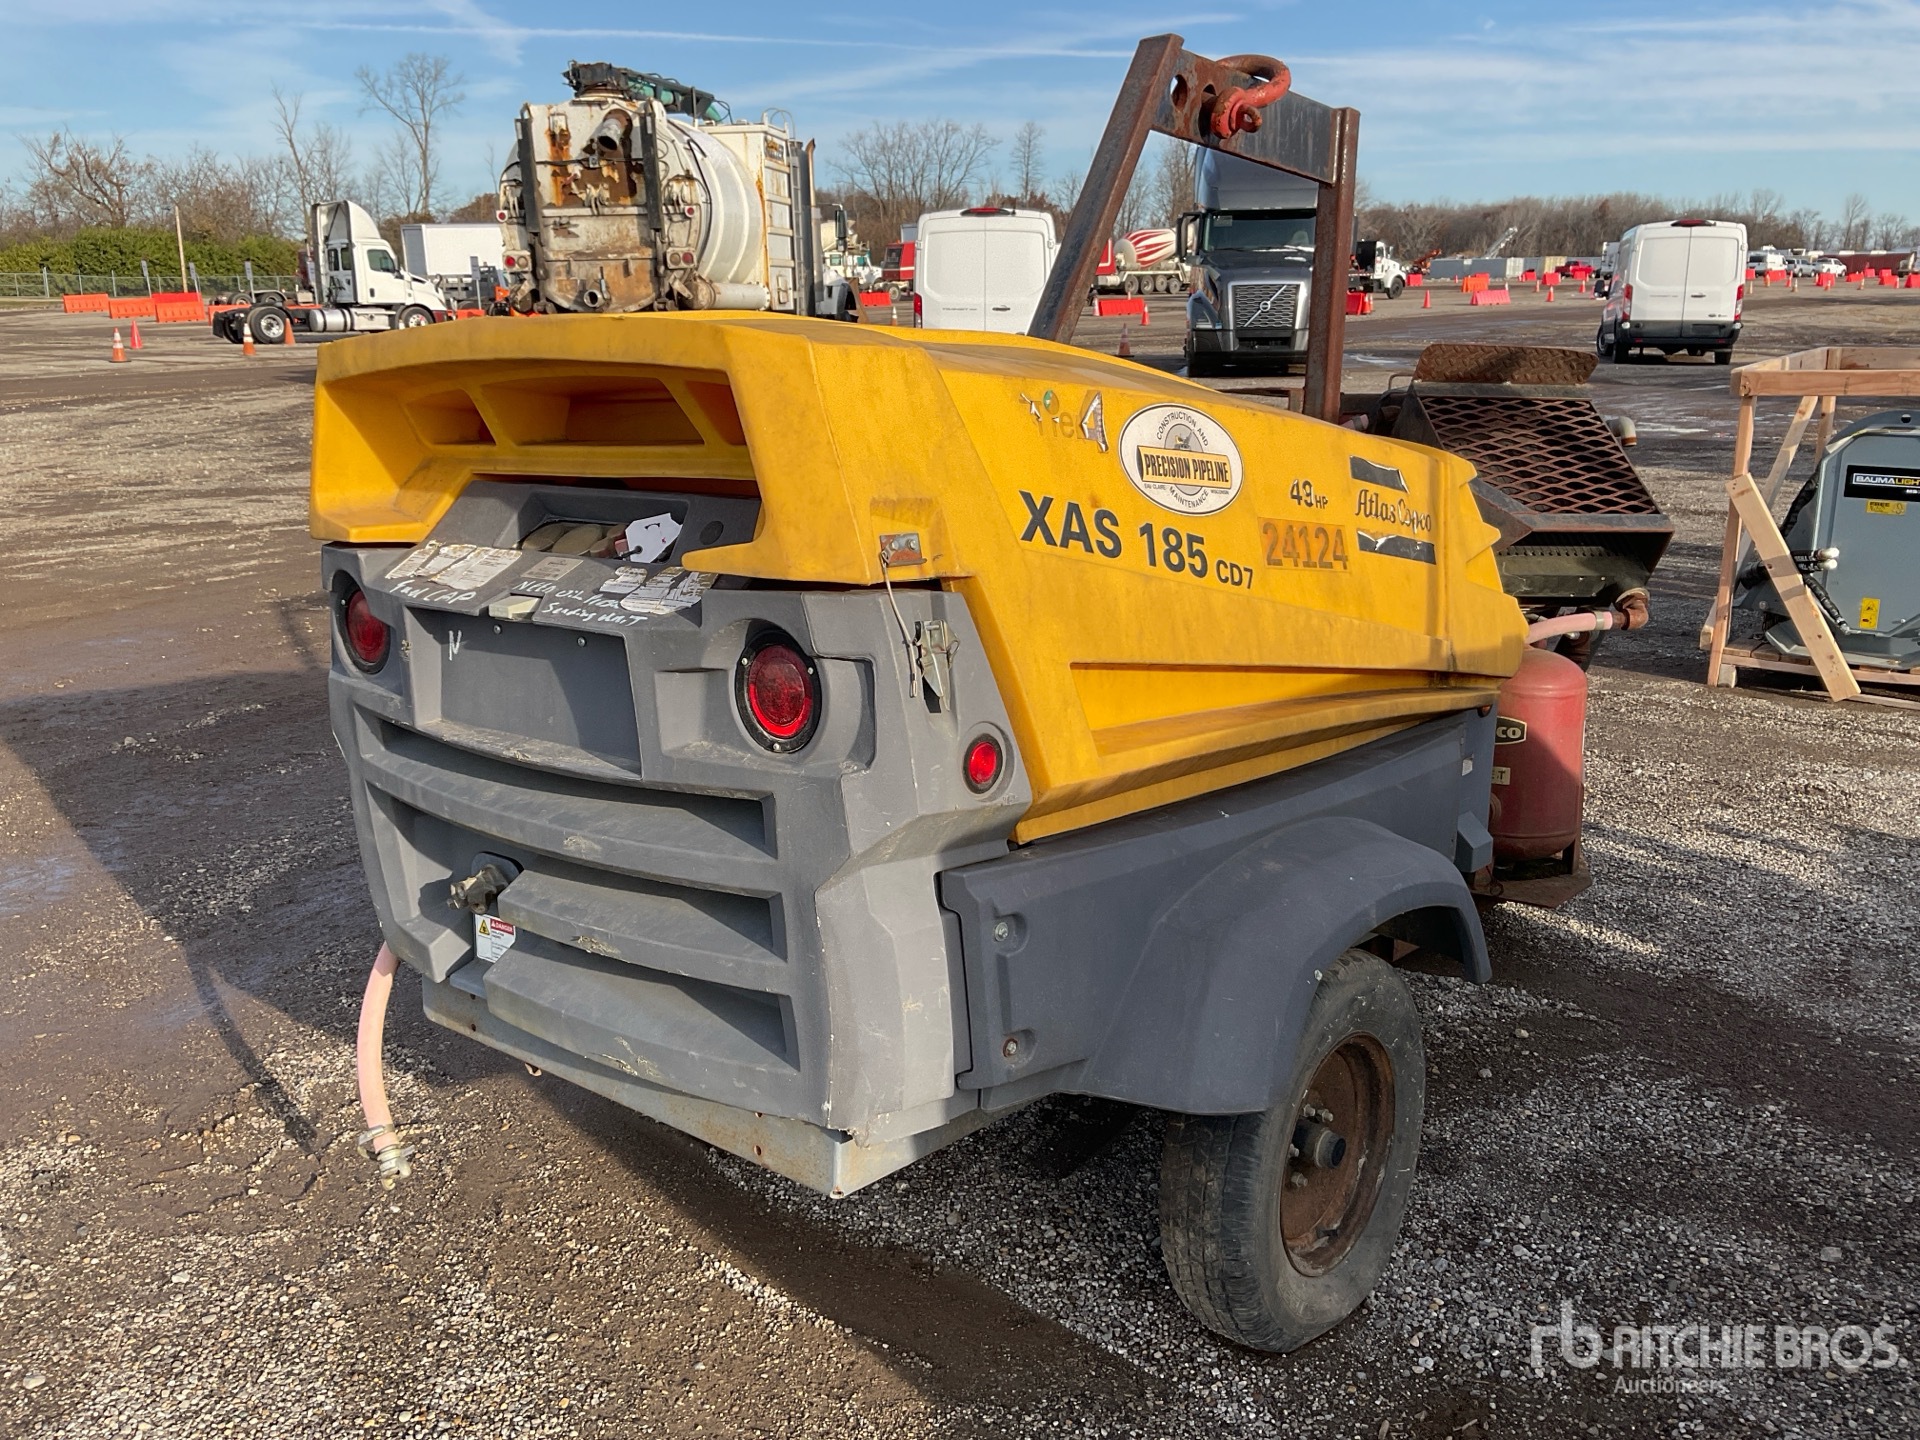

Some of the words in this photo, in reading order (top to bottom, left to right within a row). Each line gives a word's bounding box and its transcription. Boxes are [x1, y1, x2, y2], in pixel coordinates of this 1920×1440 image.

[1156, 411, 1197, 440] CONSTRUCTION
[1197, 428, 1209, 447] AND
[1143, 453, 1191, 479] PRECISION
[1191, 458, 1229, 482] PIPELINE
[1169, 485, 1209, 508] MAINTENANCE
[1355, 488, 1396, 524] Atlas
[1019, 490, 1122, 559] XAS
[1139, 522, 1208, 579] 185
[1215, 559, 1253, 590] CD7
[1263, 521, 1349, 571] 24124
